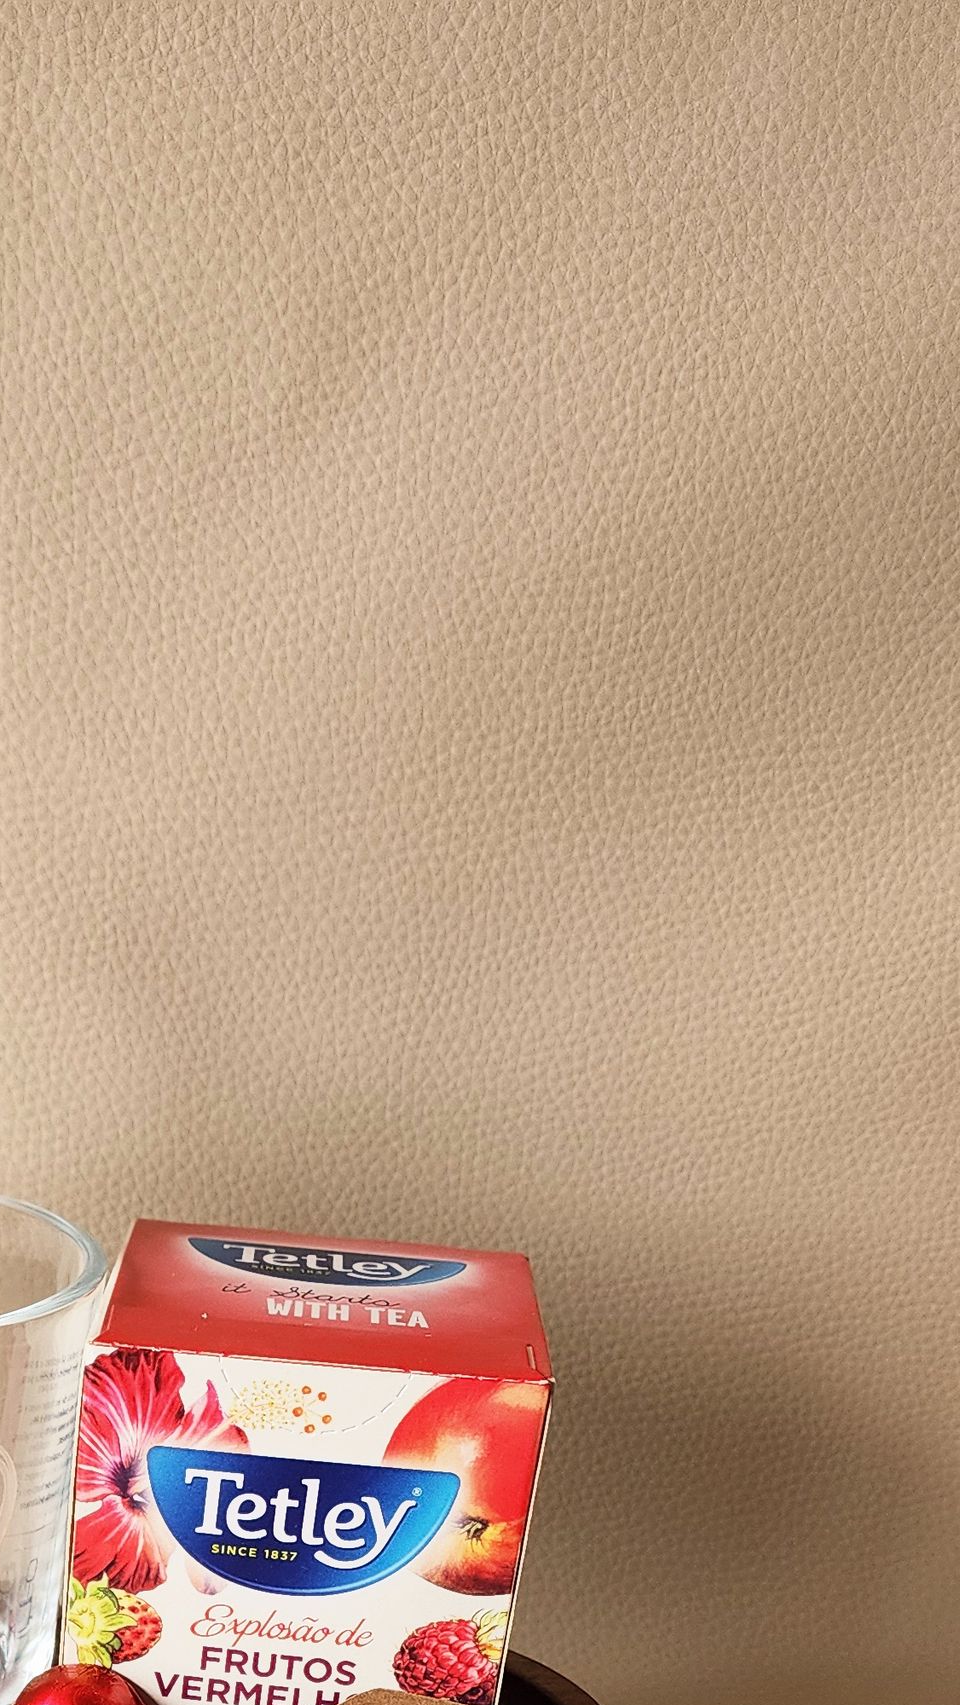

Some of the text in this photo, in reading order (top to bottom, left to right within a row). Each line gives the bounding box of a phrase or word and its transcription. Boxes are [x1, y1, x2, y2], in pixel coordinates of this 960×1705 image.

[223, 1244, 433, 1281] Tetley
[266, 1298, 429, 1329] WITH TEA
[184, 1468, 417, 1570] Tetley
[211, 1543, 298, 1562] SINCE 1837
[190, 1603, 375, 1648] Explosão de
[199, 1645, 357, 1686] FRUTOS
